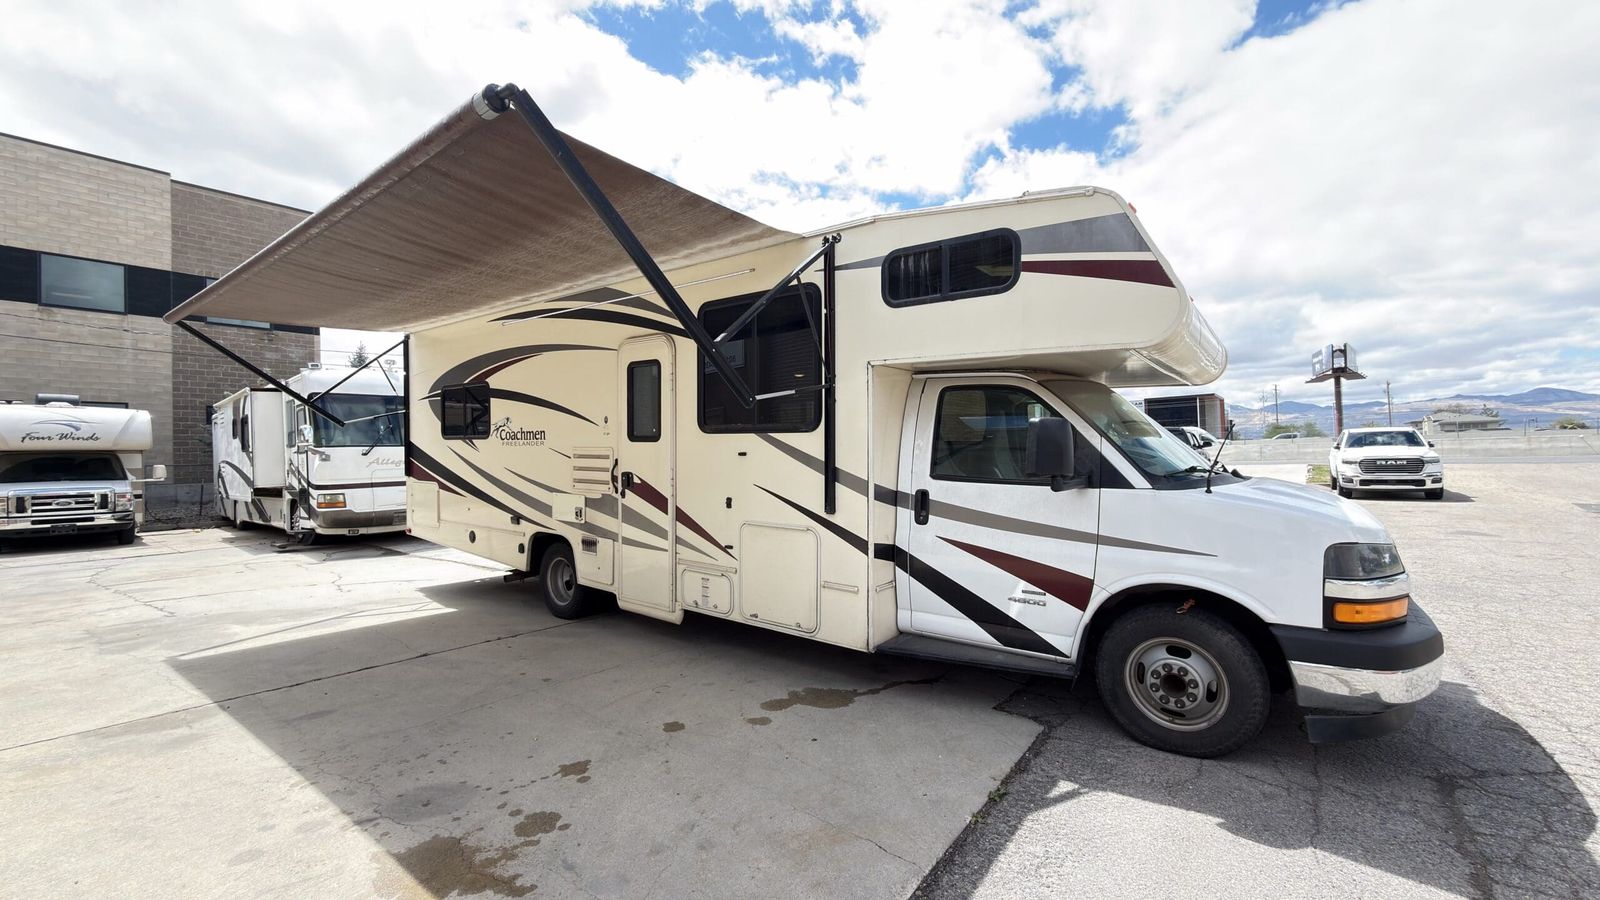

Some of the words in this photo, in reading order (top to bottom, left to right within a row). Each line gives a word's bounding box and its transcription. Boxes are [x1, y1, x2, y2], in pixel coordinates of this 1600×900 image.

[20, 432, 54, 443] Four
[56, 432, 101, 441] Winds
[499, 427, 546, 441] Coachmen
